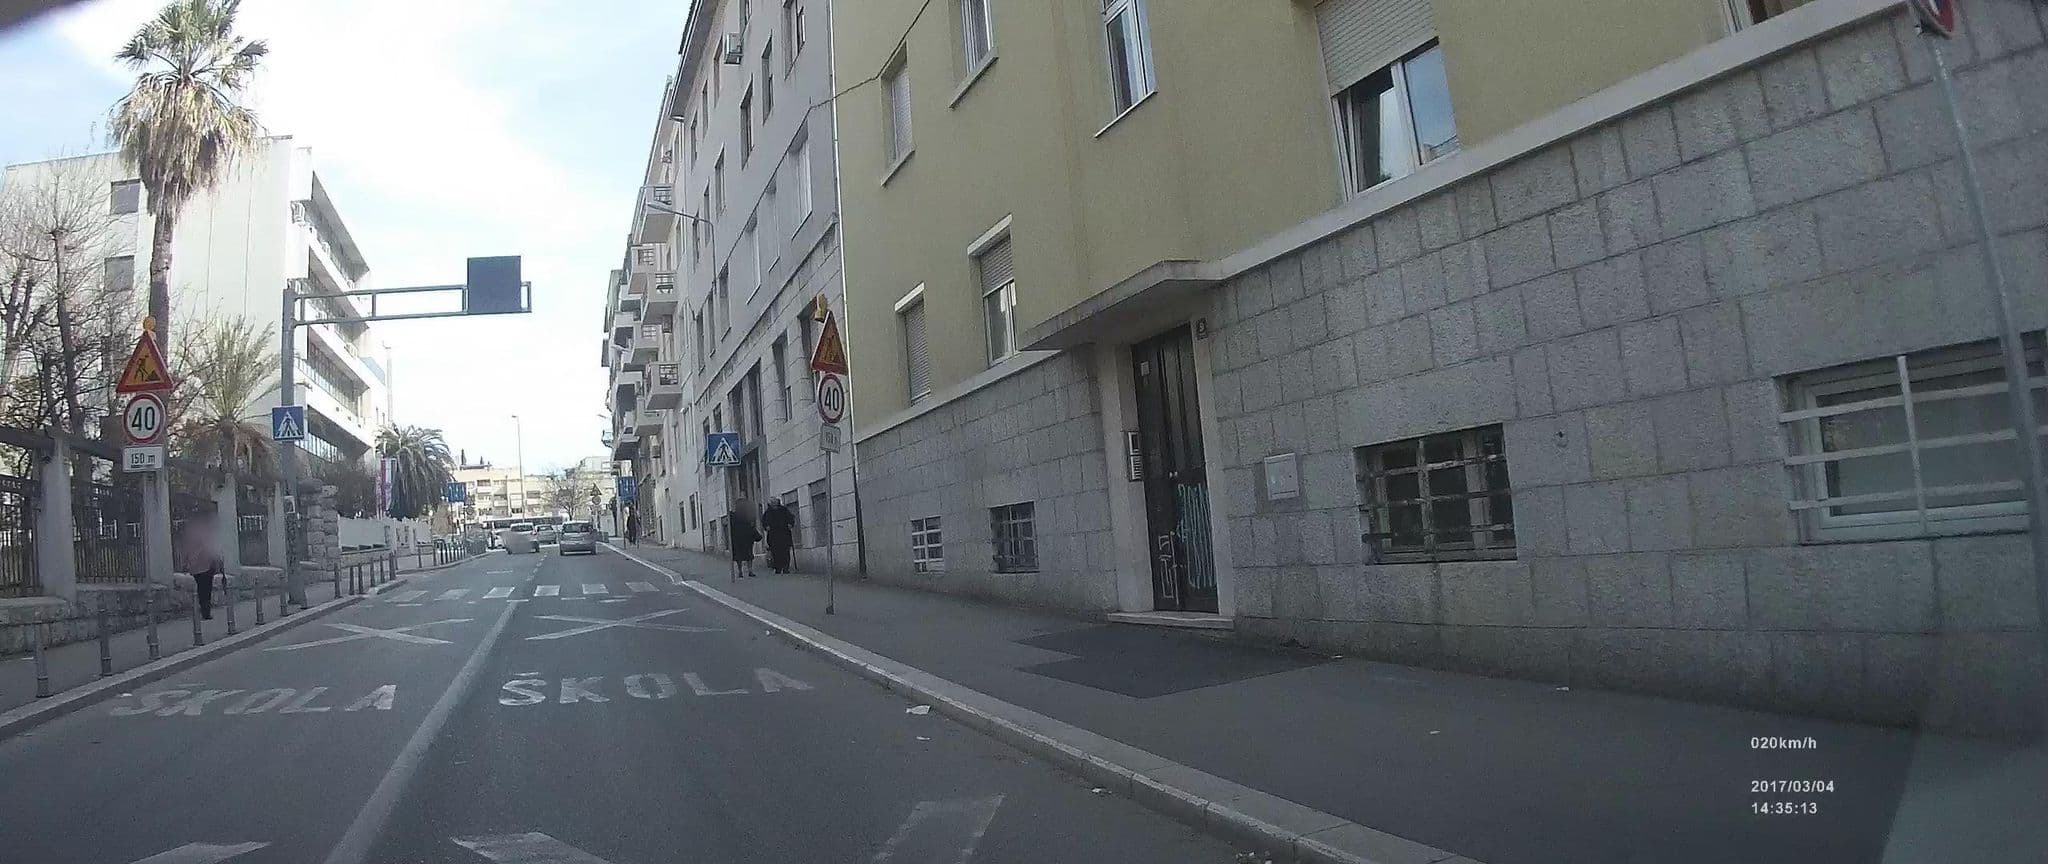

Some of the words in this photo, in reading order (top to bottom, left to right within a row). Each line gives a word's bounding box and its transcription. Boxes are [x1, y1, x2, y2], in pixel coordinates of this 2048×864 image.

[824, 387, 840, 412] 40
[131, 406, 155, 431] 40
[131, 453, 145, 464] 150
[148, 455, 156, 465] m
[499, 668, 815, 706] ŠKOLA
